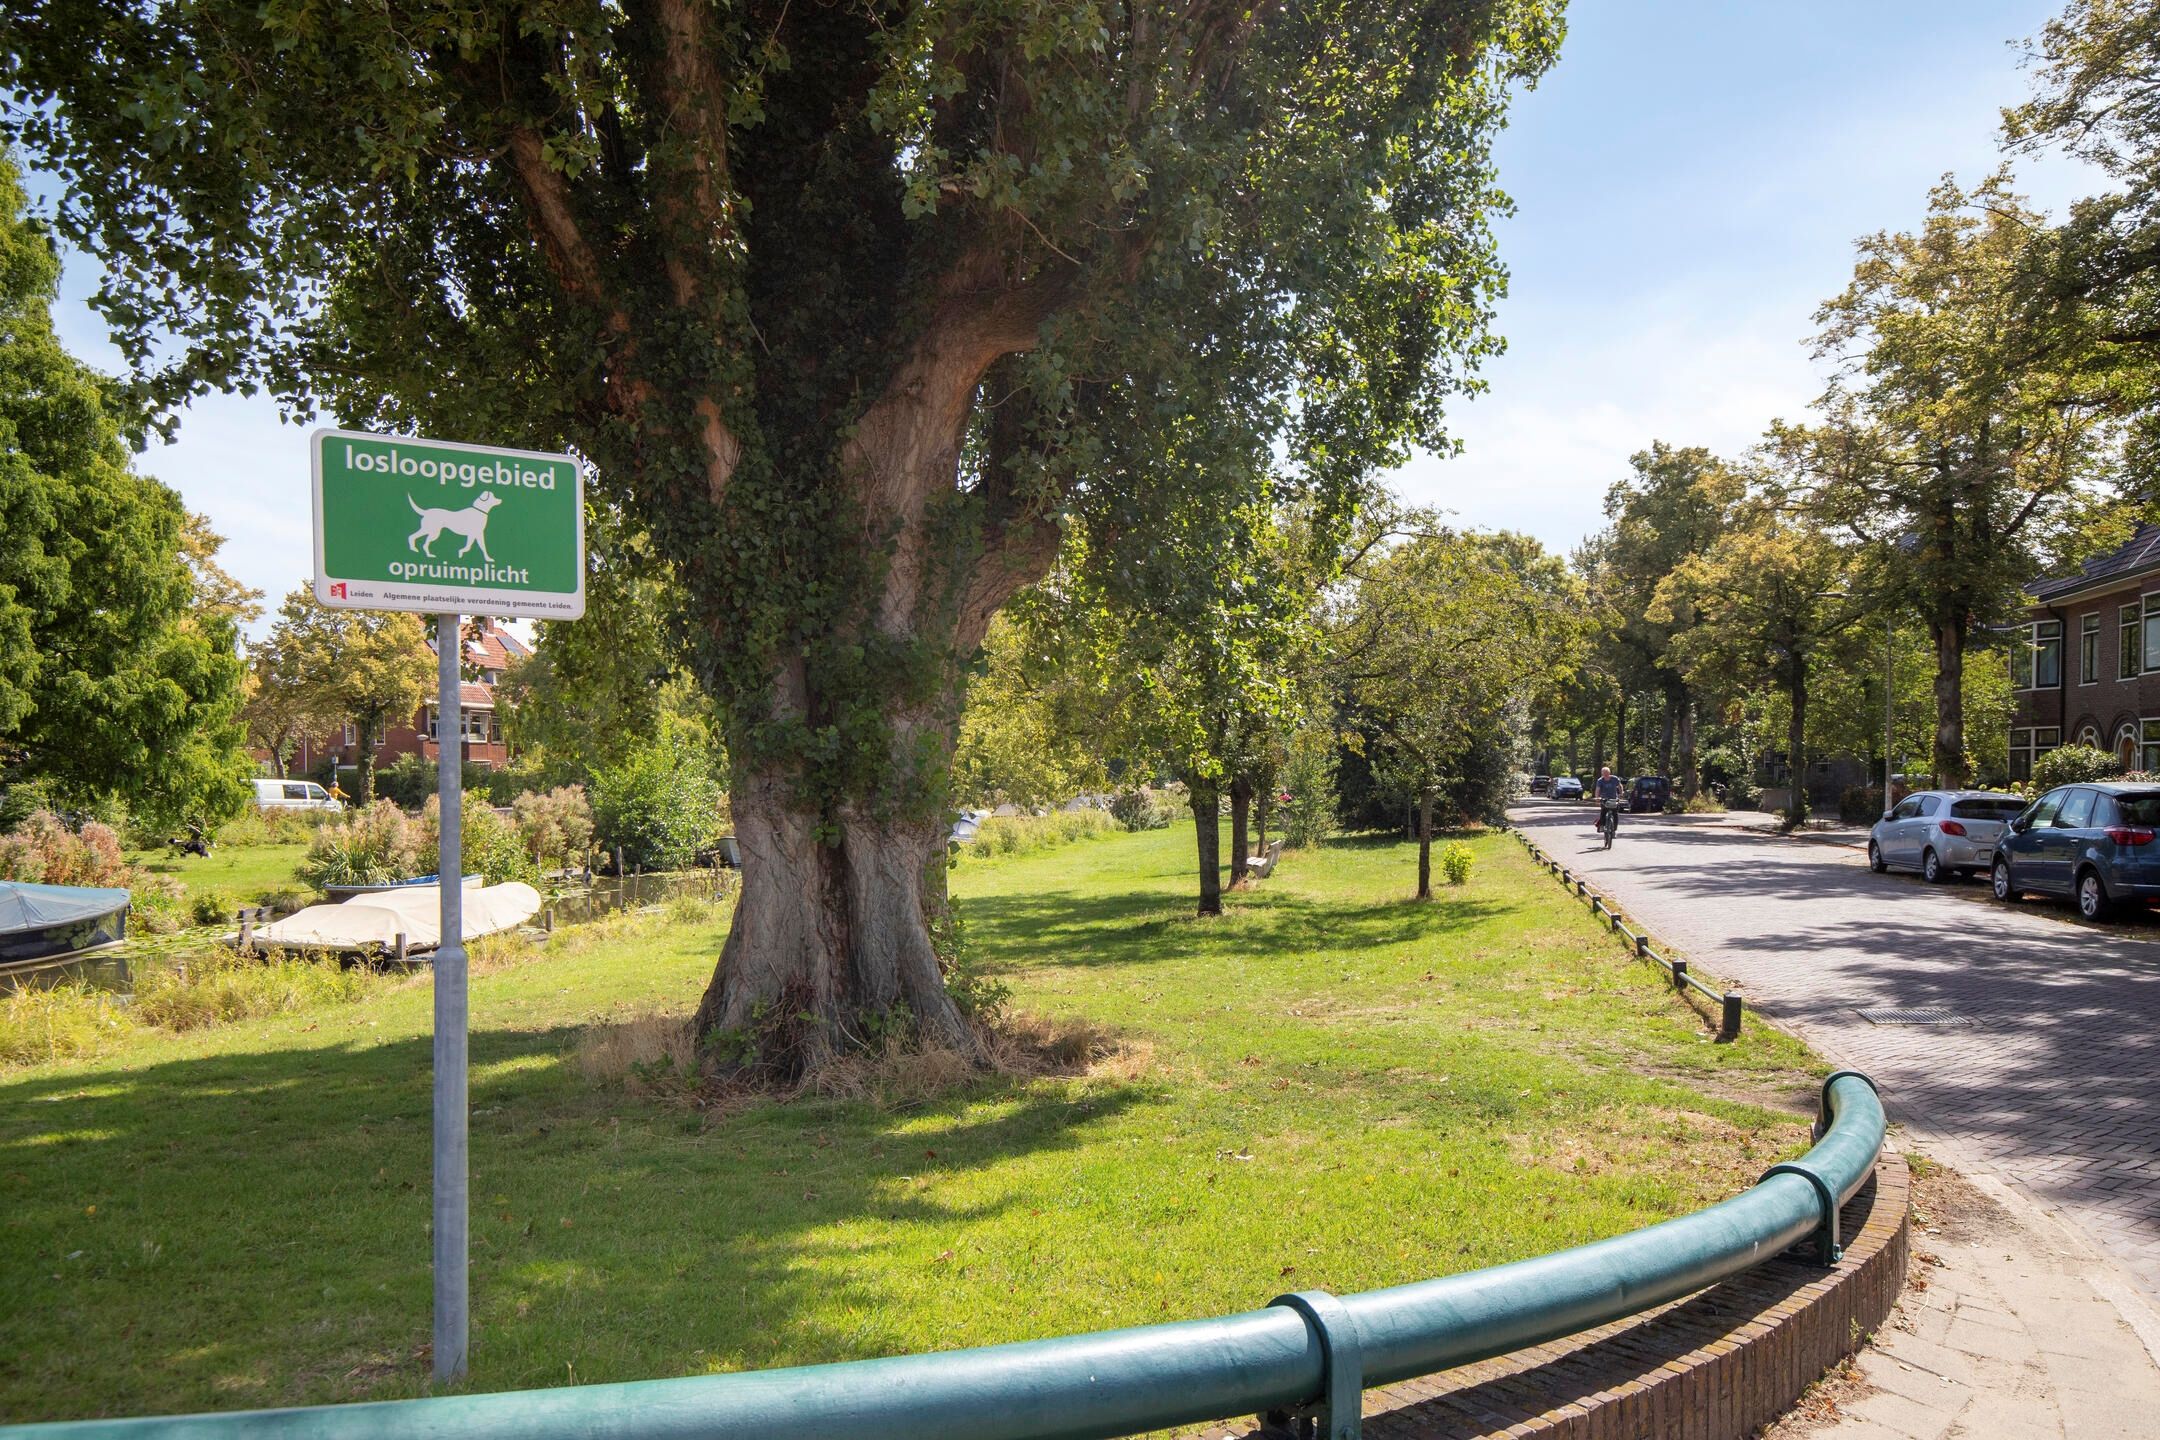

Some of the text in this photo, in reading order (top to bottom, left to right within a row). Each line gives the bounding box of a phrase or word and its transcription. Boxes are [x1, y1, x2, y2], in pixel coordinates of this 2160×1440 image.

[345, 445, 556, 490] losloopgebied
[388, 561, 530, 584] opruimplicht
[383, 592, 574, 610] Algemene plaatselijke verordening gemeente Leiden.
